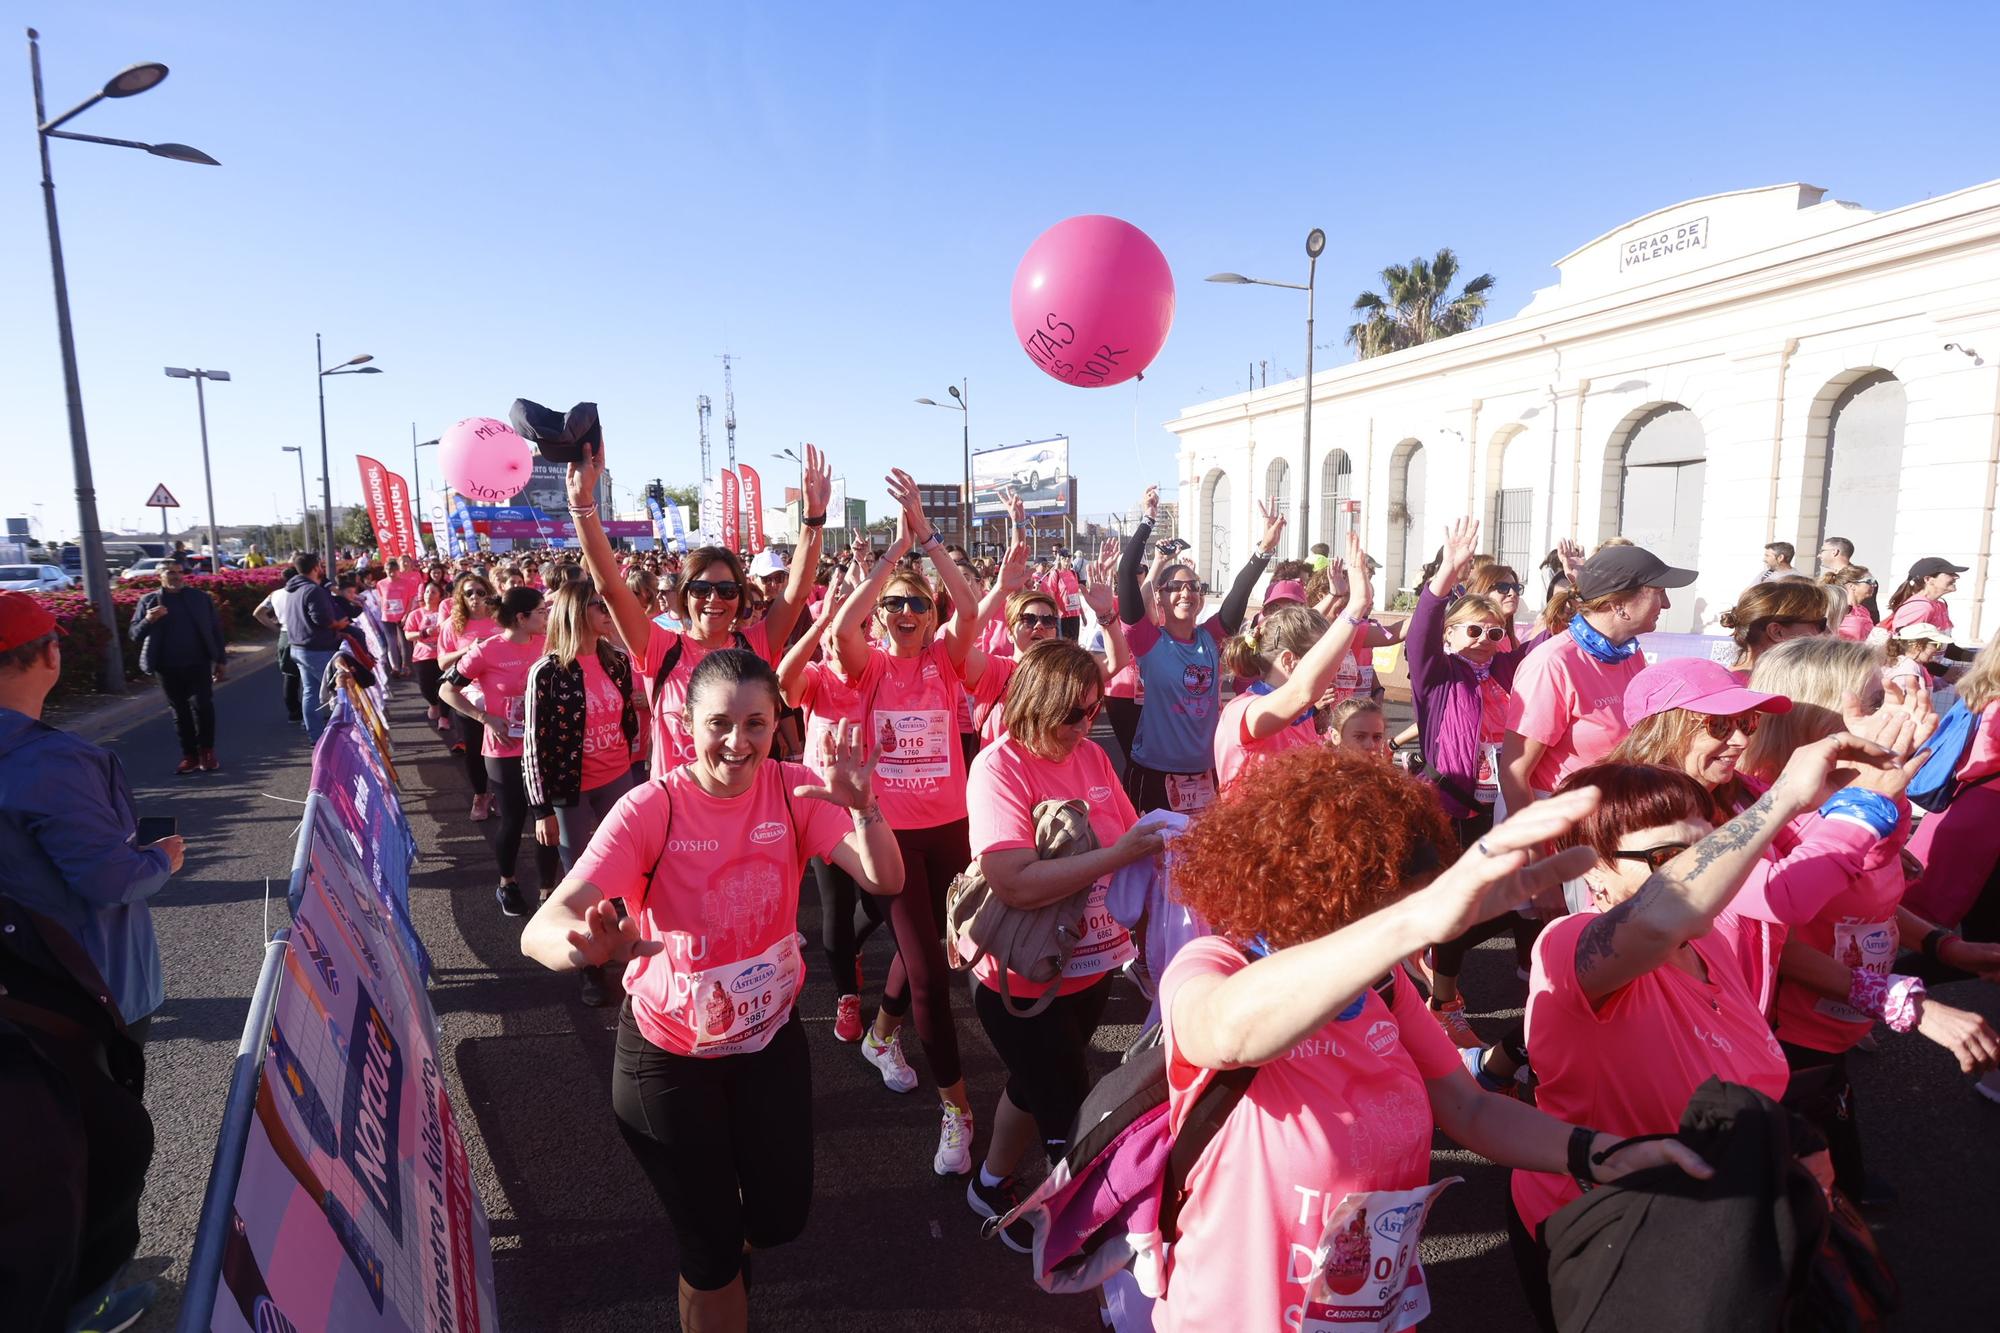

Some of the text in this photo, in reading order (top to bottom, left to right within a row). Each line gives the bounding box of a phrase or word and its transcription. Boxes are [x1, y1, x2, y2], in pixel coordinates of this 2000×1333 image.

[1625, 236, 1701, 267] VALENCIA
[1628, 224, 1700, 255] GRAO DE
[899, 736, 925, 749] 016
[668, 839, 720, 852] OYSHO
[672, 935, 706, 961] TU
[1070, 959, 1101, 970] OYSHO
[735, 969, 774, 991] ASTURIANA
[737, 990, 772, 1017] 016
[744, 1009, 767, 1027] 3987
[354, 1006, 392, 1211] Norauto
[428, 1179, 443, 1207] a
[1325, 1308, 1371, 1319] CARRERA
